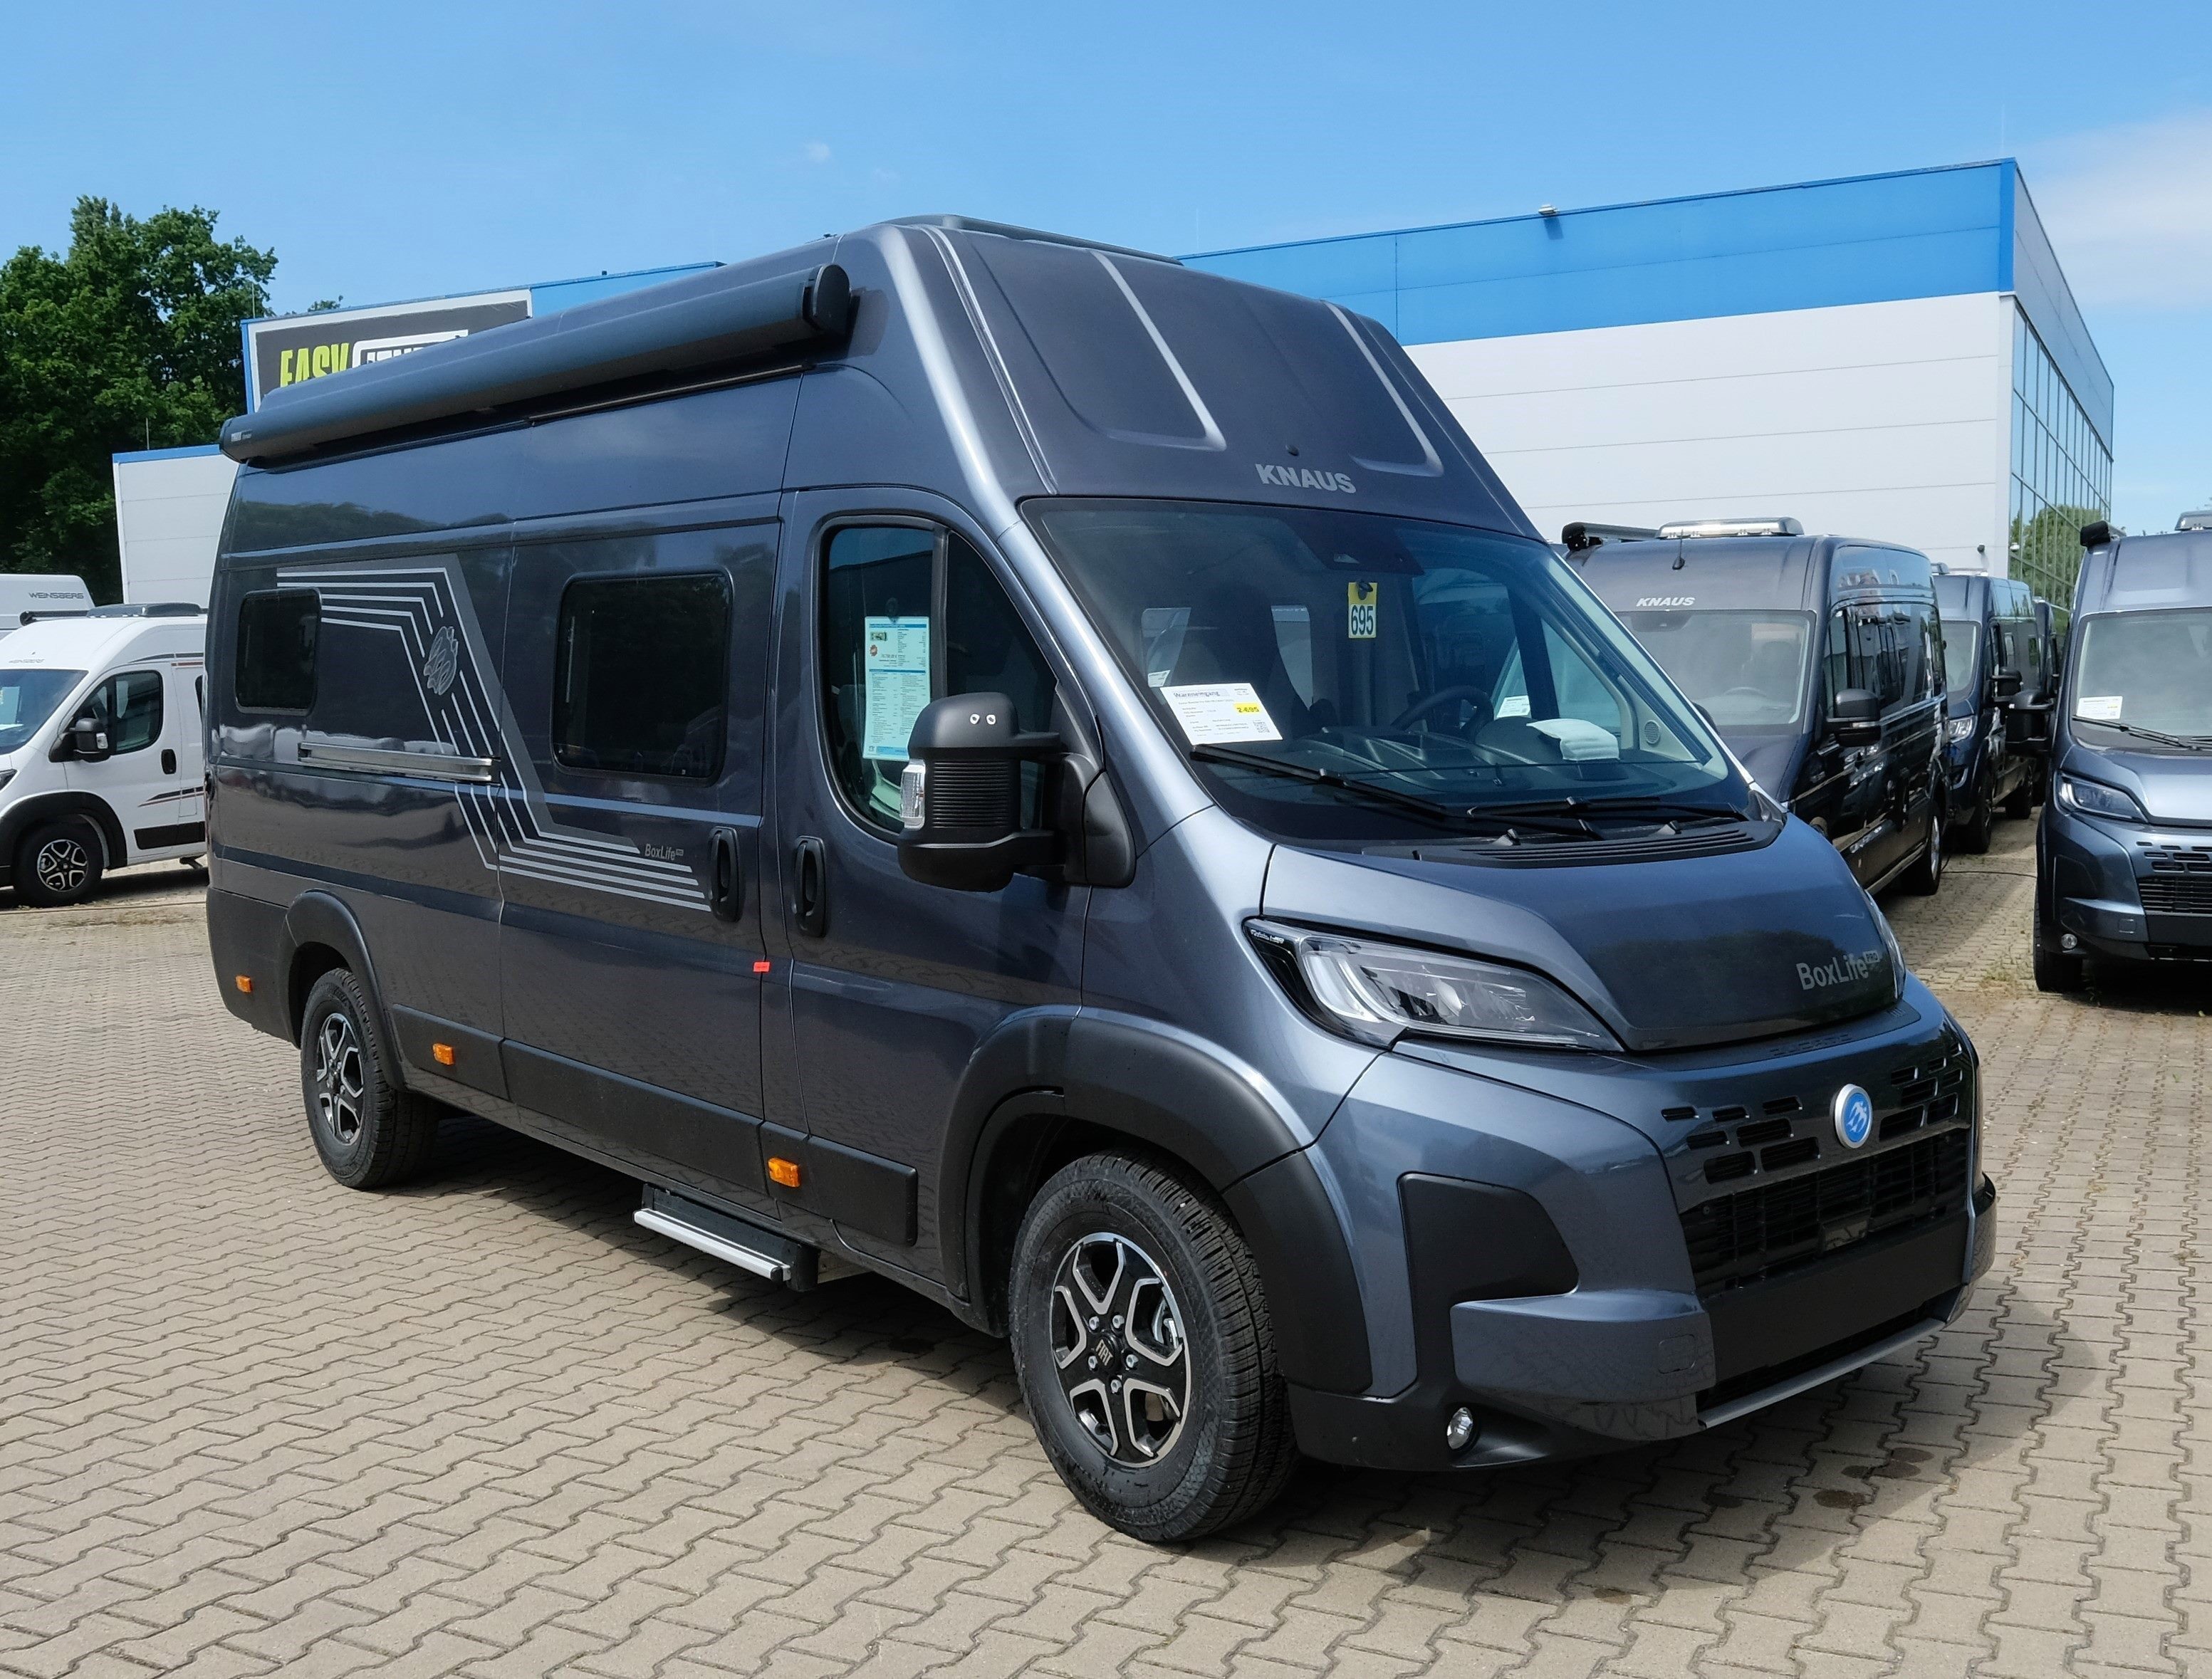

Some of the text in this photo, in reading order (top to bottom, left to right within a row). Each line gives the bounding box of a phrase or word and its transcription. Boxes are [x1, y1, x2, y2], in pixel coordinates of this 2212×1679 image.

[1256, 464, 1357, 494] KNAUS
[1636, 597, 1696, 607] KNAUS
[1350, 605, 1374, 635] 695
[645, 843, 676, 861] BoxLife
[1796, 953, 1869, 991] BoxLife
[1095, 1339, 1114, 1366] FIAT
